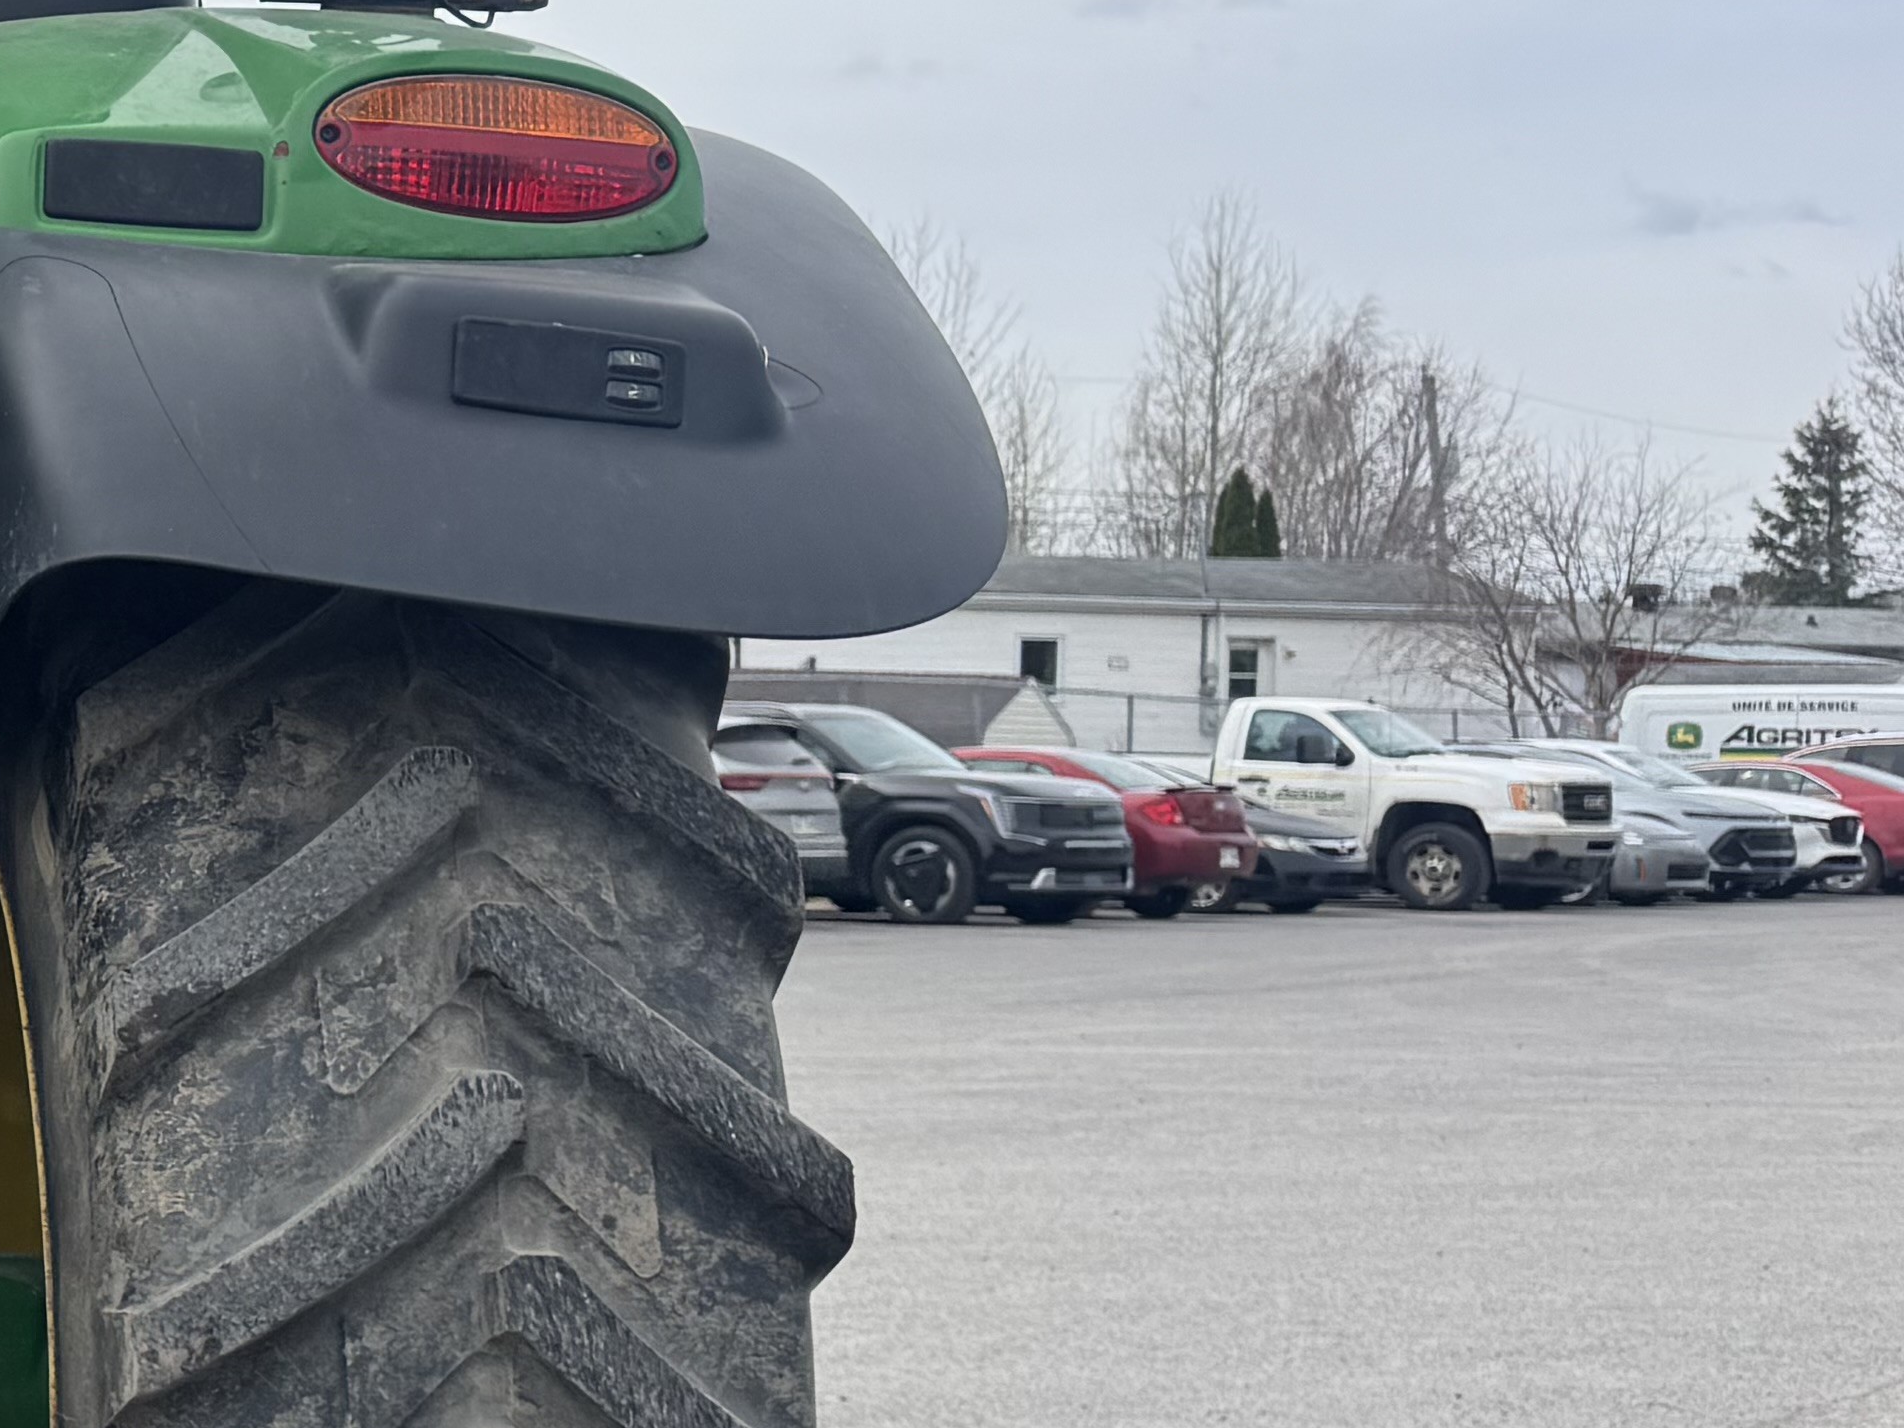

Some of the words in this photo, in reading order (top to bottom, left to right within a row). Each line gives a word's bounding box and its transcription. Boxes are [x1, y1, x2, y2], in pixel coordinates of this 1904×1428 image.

[1777, 700, 1794, 712] DE
[1799, 700, 1859, 712] SERVICE
[1723, 723, 1879, 745] AGRIT
